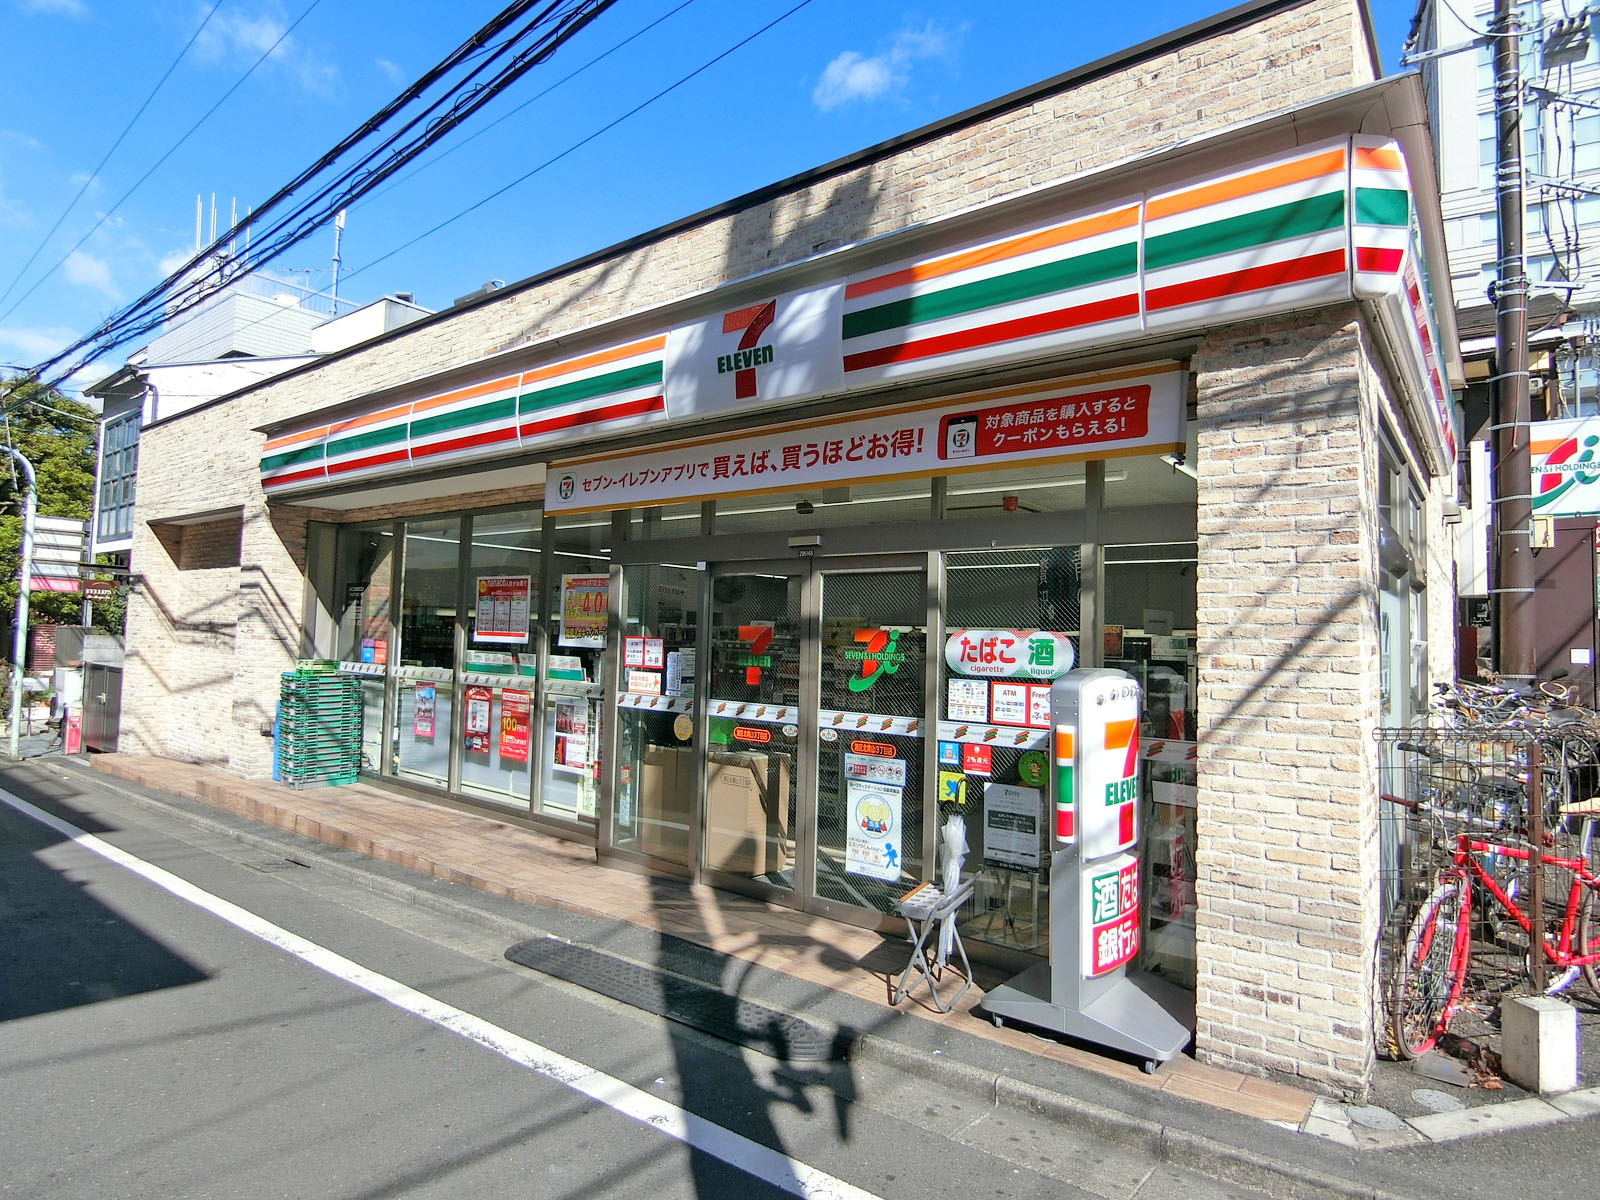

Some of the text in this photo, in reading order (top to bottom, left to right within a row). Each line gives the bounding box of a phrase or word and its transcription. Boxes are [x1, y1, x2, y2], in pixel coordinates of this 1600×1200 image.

[717, 344, 774, 374] ELEVEN
[722, 299, 777, 400] 7
[984, 396, 1137, 431] 対象商品を購入すると
[993, 416, 1126, 448] クーポンもらえる!
[738, 625, 773, 685] 7
[872, 652, 905, 661] HOLDINGS
[960, 636, 1055, 666] たばこ 酒
[970, 665, 1054, 676] cigarette liquor
[1002, 689, 1017, 697] ATM
[1032, 691, 1045, 699] Free
[1094, 879, 1118, 923] 酒
